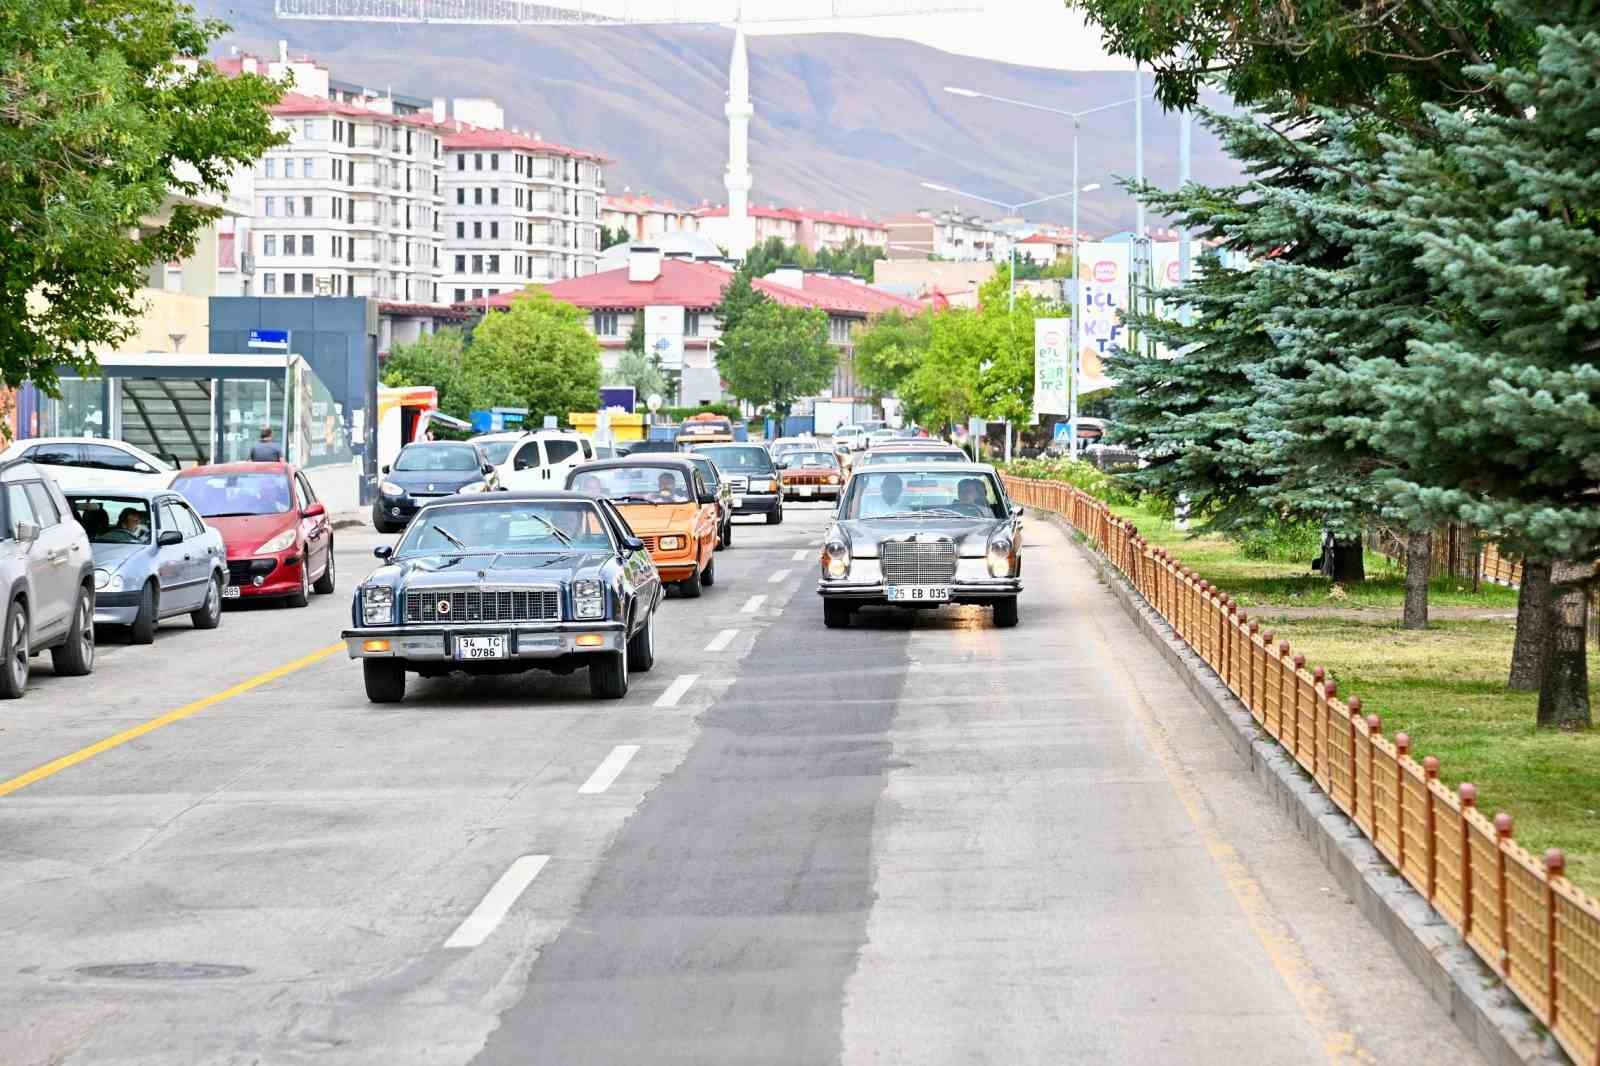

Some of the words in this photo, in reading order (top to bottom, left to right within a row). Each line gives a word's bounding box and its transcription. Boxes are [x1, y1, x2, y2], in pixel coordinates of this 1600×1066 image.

[895, 588, 904, 598] 25
[912, 588, 923, 598] EB
[930, 588, 946, 598] 035
[463, 638, 475, 648] 34
[488, 637, 500, 647] TC
[470, 648, 496, 657] 0786
